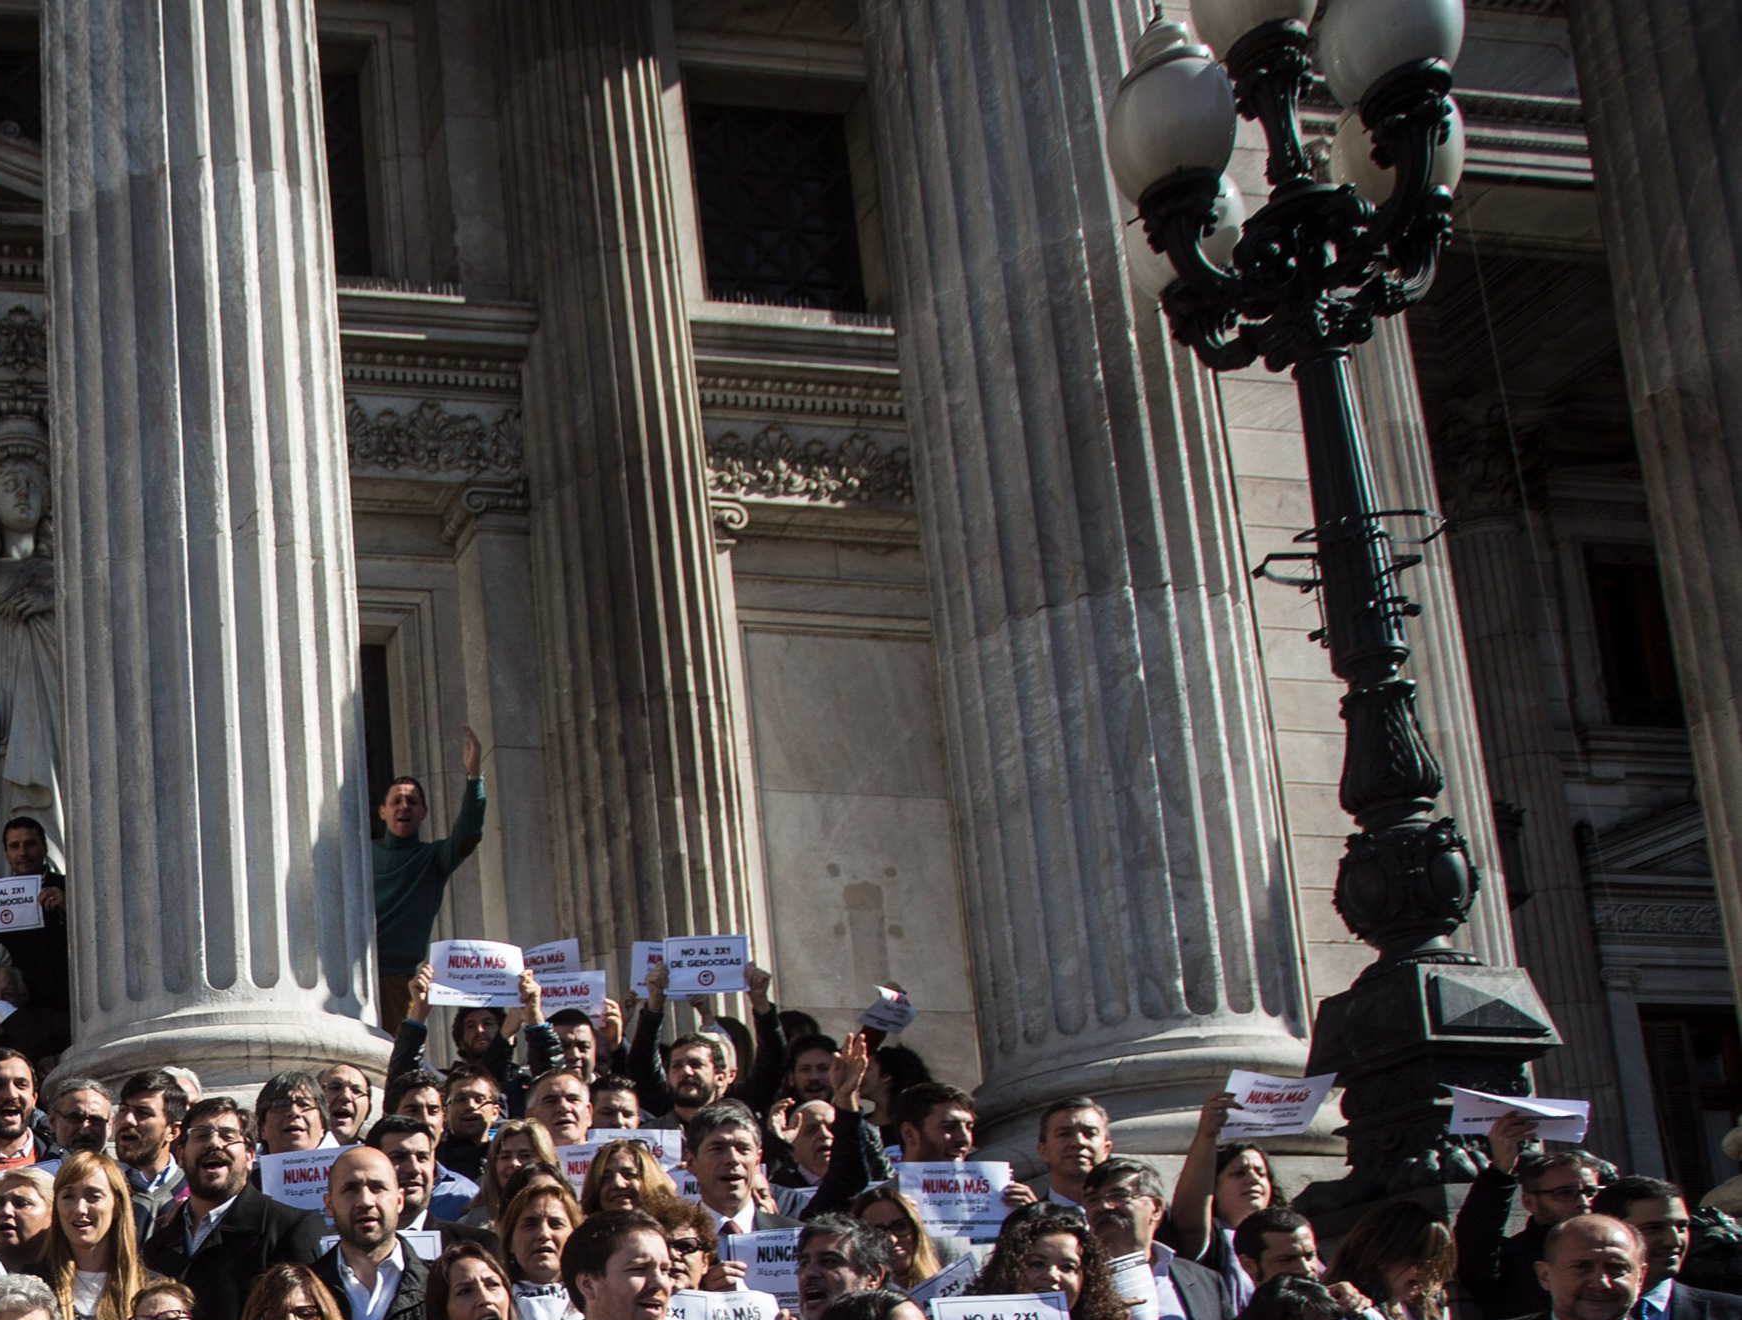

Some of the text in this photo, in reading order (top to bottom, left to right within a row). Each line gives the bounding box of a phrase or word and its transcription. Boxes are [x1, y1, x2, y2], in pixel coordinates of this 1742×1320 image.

[11, 887, 26, 895] 2X1
[547, 950, 566, 963] MÁS
[681, 947, 731, 956] NO AL 2X1
[447, 953, 507, 969] NUNCA MÁS
[670, 958, 742, 968] DE GENOCIDAS
[570, 983, 590, 996] MÁS
[1245, 1087, 1312, 1105] NUNCA MÁS
[283, 1166, 321, 1185] NUNCA
[922, 1176, 990, 1194] NUNCA MÁS
[756, 1246, 800, 1263] NUNCA
[939, 1280, 961, 1298] 2X1
